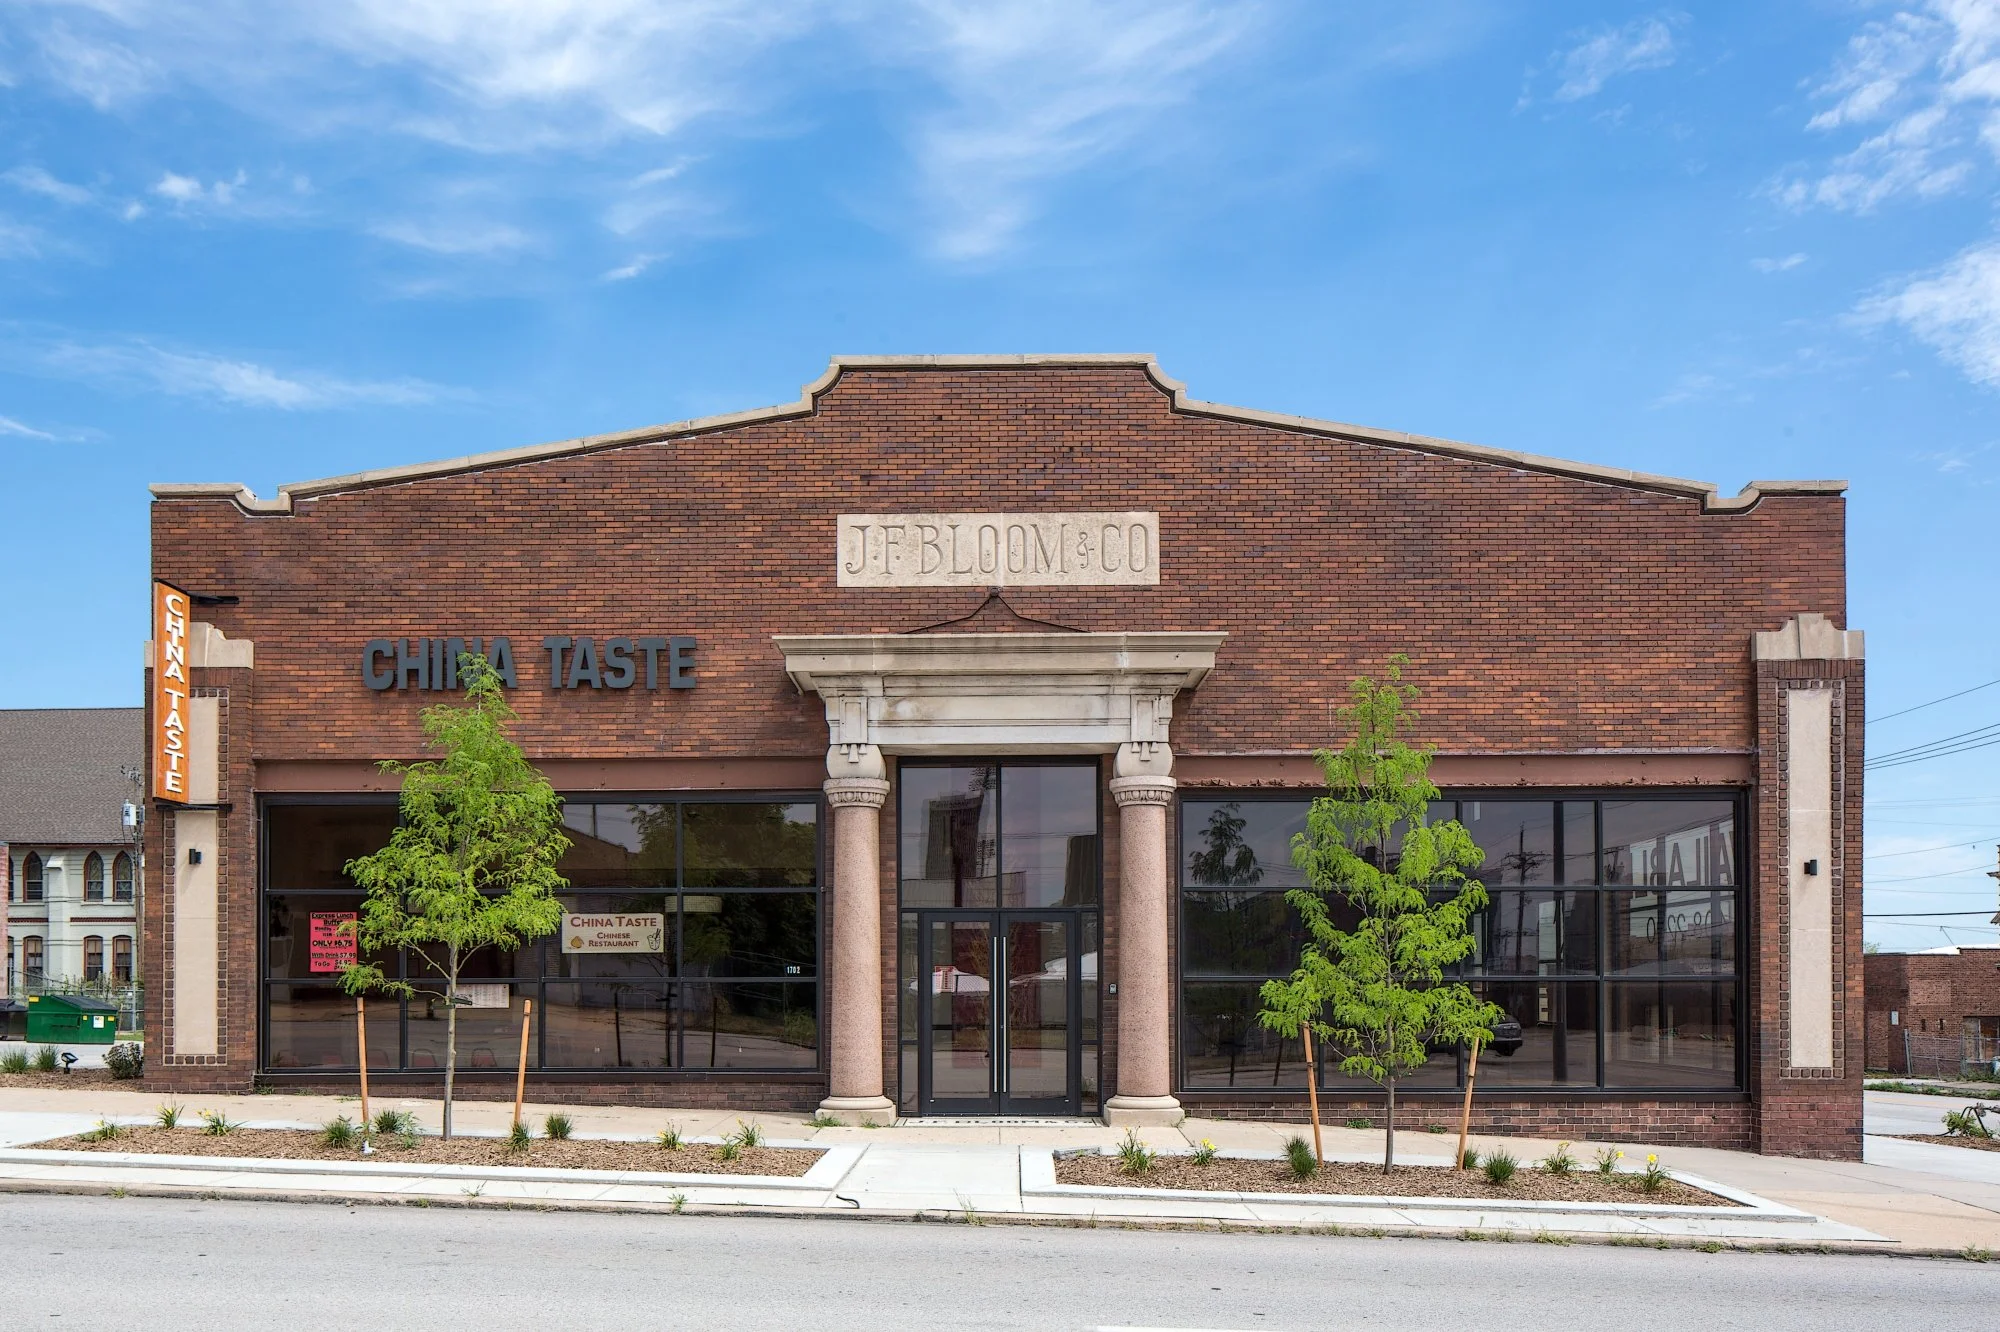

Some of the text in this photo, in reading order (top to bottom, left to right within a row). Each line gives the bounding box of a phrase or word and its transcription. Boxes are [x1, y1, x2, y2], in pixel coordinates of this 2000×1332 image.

[914, 524, 1068, 574] BLOOM
[1076, 531, 1095, 569] &
[1101, 523, 1150, 573] CO
[362, 636, 697, 691] CHINA TASTE
[163, 593, 185, 793] CHINA TASTE
[570, 916, 657, 927] CHINA TASTE
[787, 966, 800, 974] 1702
